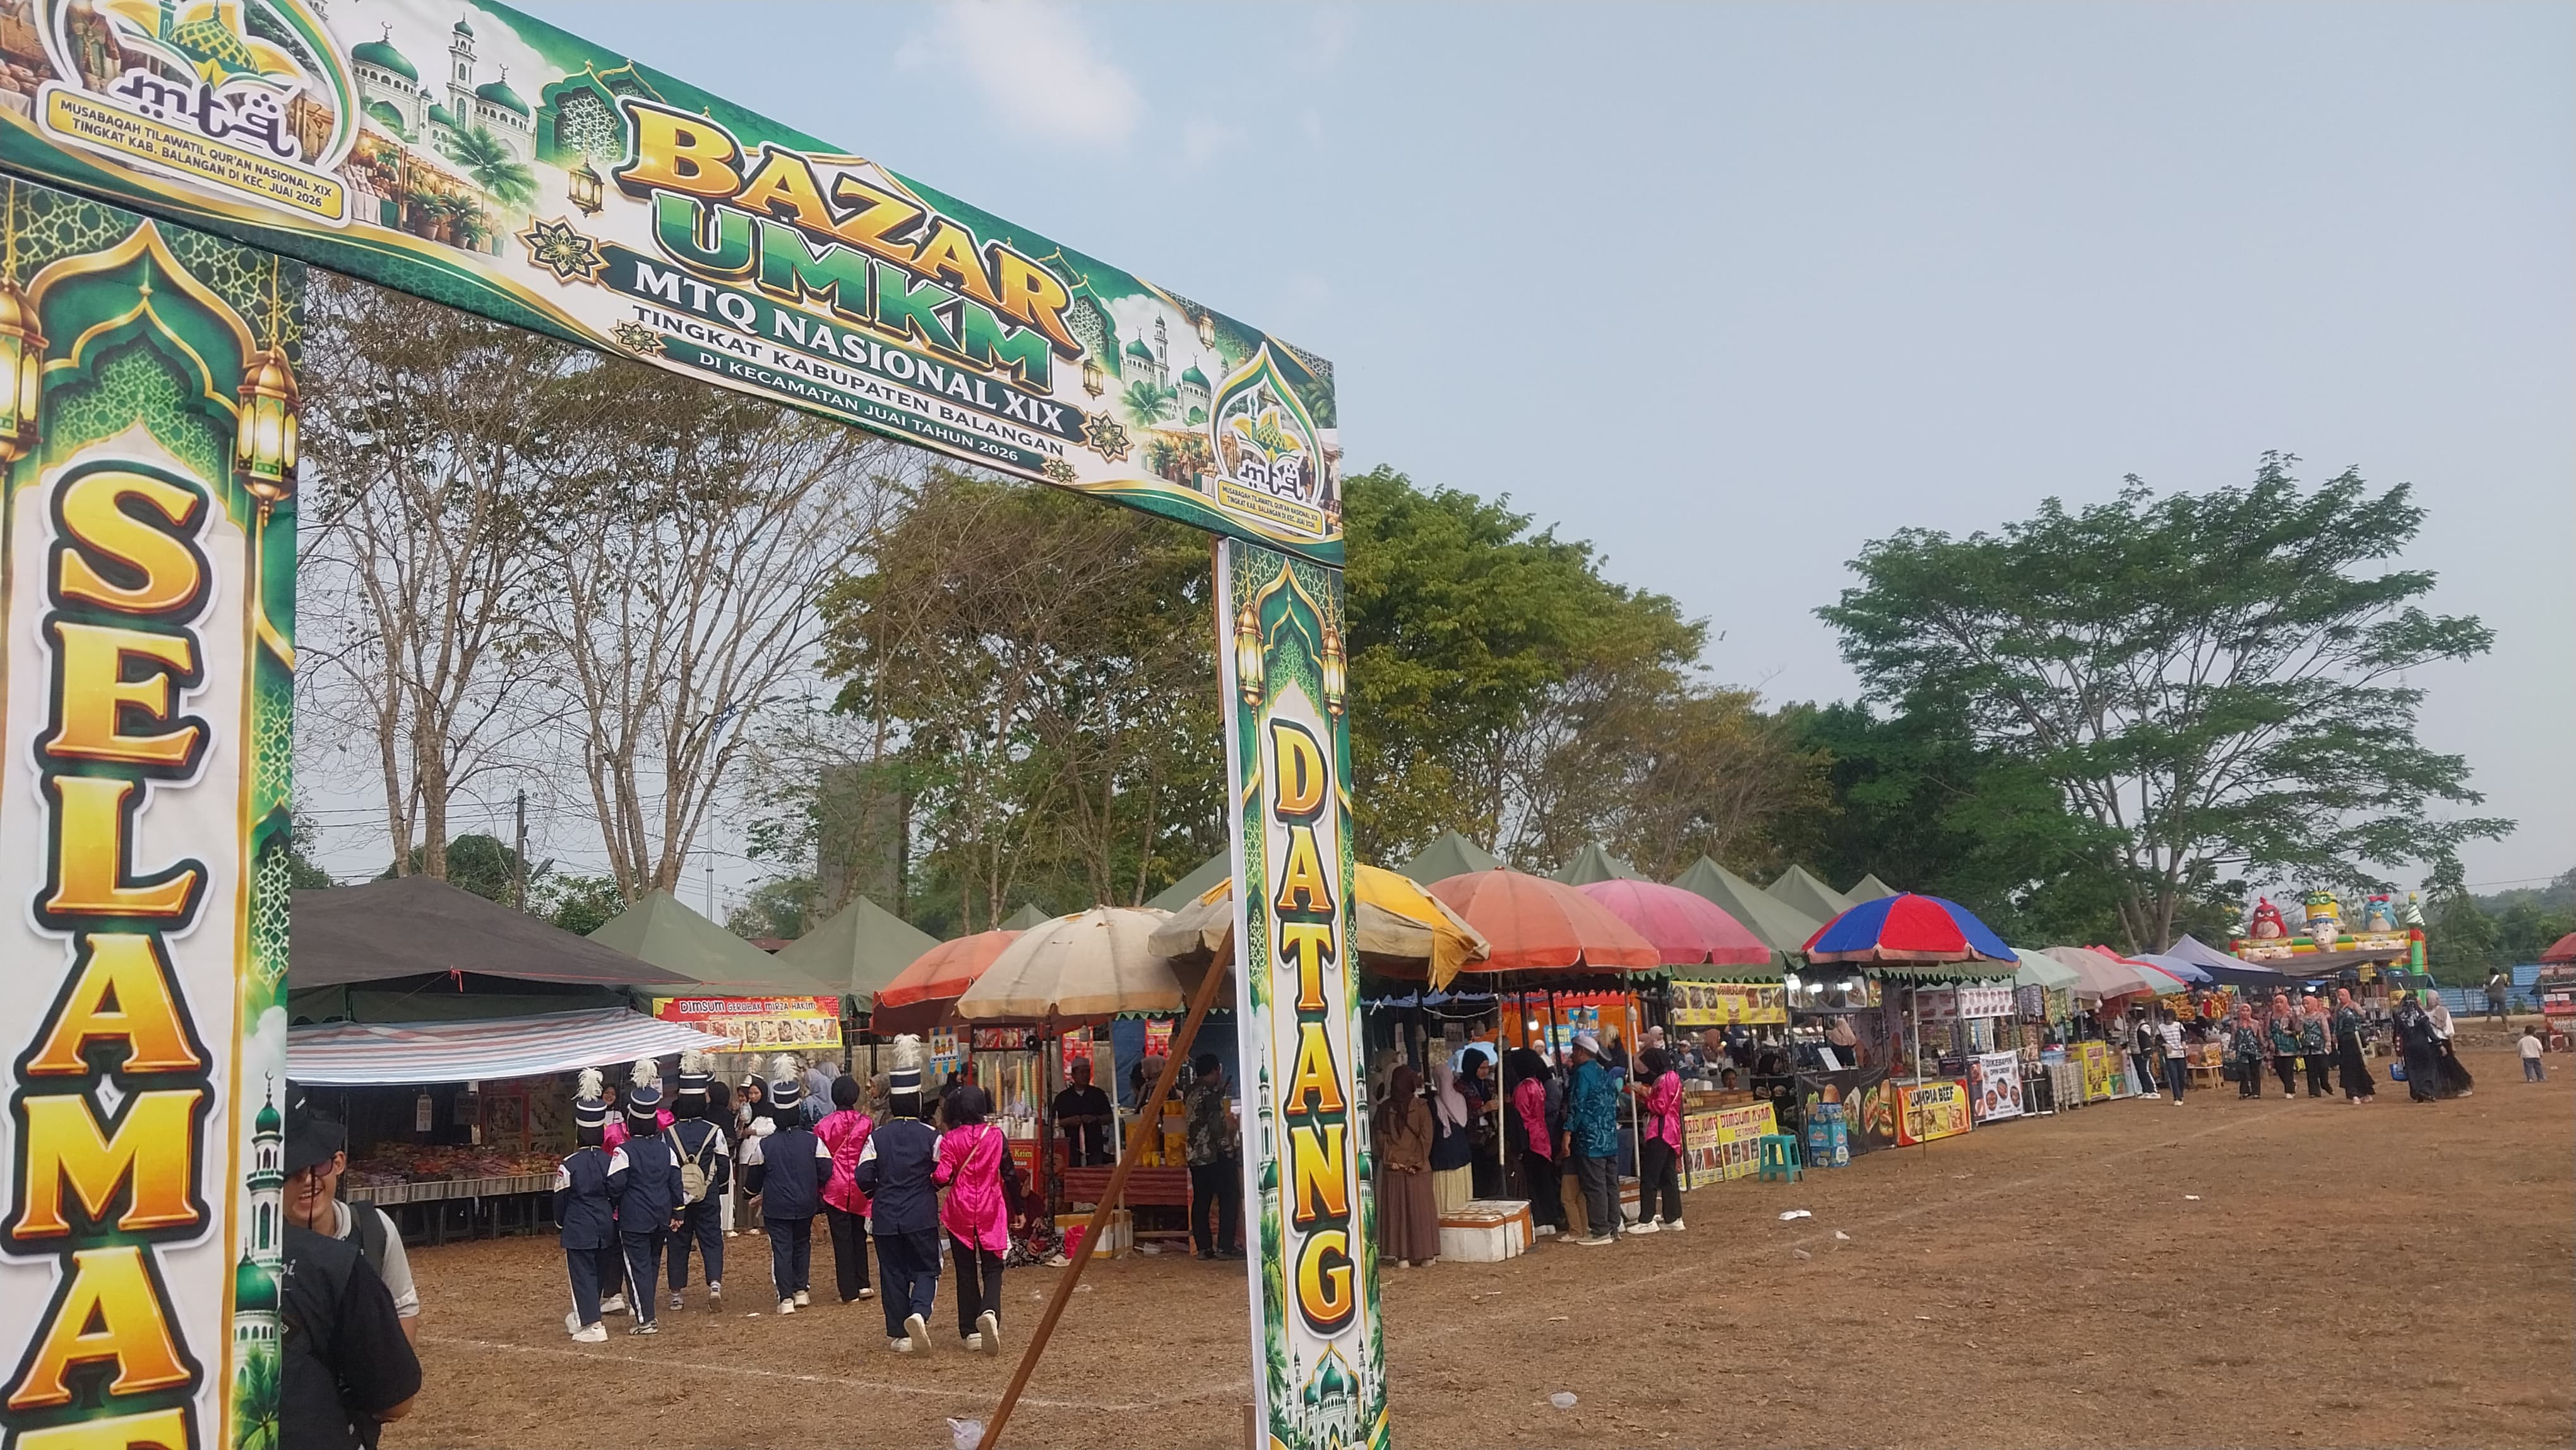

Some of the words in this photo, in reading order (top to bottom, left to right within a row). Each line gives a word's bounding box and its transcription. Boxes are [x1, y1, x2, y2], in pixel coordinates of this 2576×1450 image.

[60, 100, 141, 135] MUSABAQAH
[145, 128, 206, 156] TILAWATIL
[209, 149, 252, 171] QUR'AN
[255, 164, 310, 190] NASIONAL
[313, 183, 332, 198] XIX
[72, 117, 125, 143] TINGKAT
[128, 136, 157, 155] KAB.
[162, 148, 225, 176] BALANGAN
[228, 168, 239, 181] DI
[242, 174, 266, 189] KEC.
[268, 182, 293, 198] JUAI
[295, 191, 322, 207] 2026
[619, 104, 1083, 355] BAZAR
[654, 192, 1053, 393] UMKM
[633, 260, 760, 335] MTQ
[773, 308, 998, 410] NASIONAL
[1002, 388, 1065, 433] XIX
[633, 304, 763, 358] TINGKAT
[772, 351, 930, 414] KABUPATEN
[939, 405, 1064, 457] BALANGAN
[700, 352, 721, 369] DI
[729, 361, 859, 411] KECAMATAN
[864, 404, 906, 426] JUAI
[911, 419, 974, 448] TAHUN
[979, 441, 1018, 462] 2026
[1222, 486, 1251, 499] MUSABAQAH
[1291, 508, 1311, 519] NASIONAL
[1227, 496, 1246, 506] TINGKAT
[1258, 505, 1281, 518] BALANGAN
[6, 467, 205, 1450] SELAMA
[680, 1001, 725, 1013] DIMSUM
[727, 1002, 762, 1012] GEROBAK
[765, 1002, 789, 1010] MIRZA
[791, 1002, 816, 1010] HAKIM
[1270, 723, 1354, 1326] DATANG
[1684, 1119, 1699, 1134] OSIS
[1720, 1110, 1750, 1129] DIMSUM
[1938, 1086, 1953, 1102] BEEF
